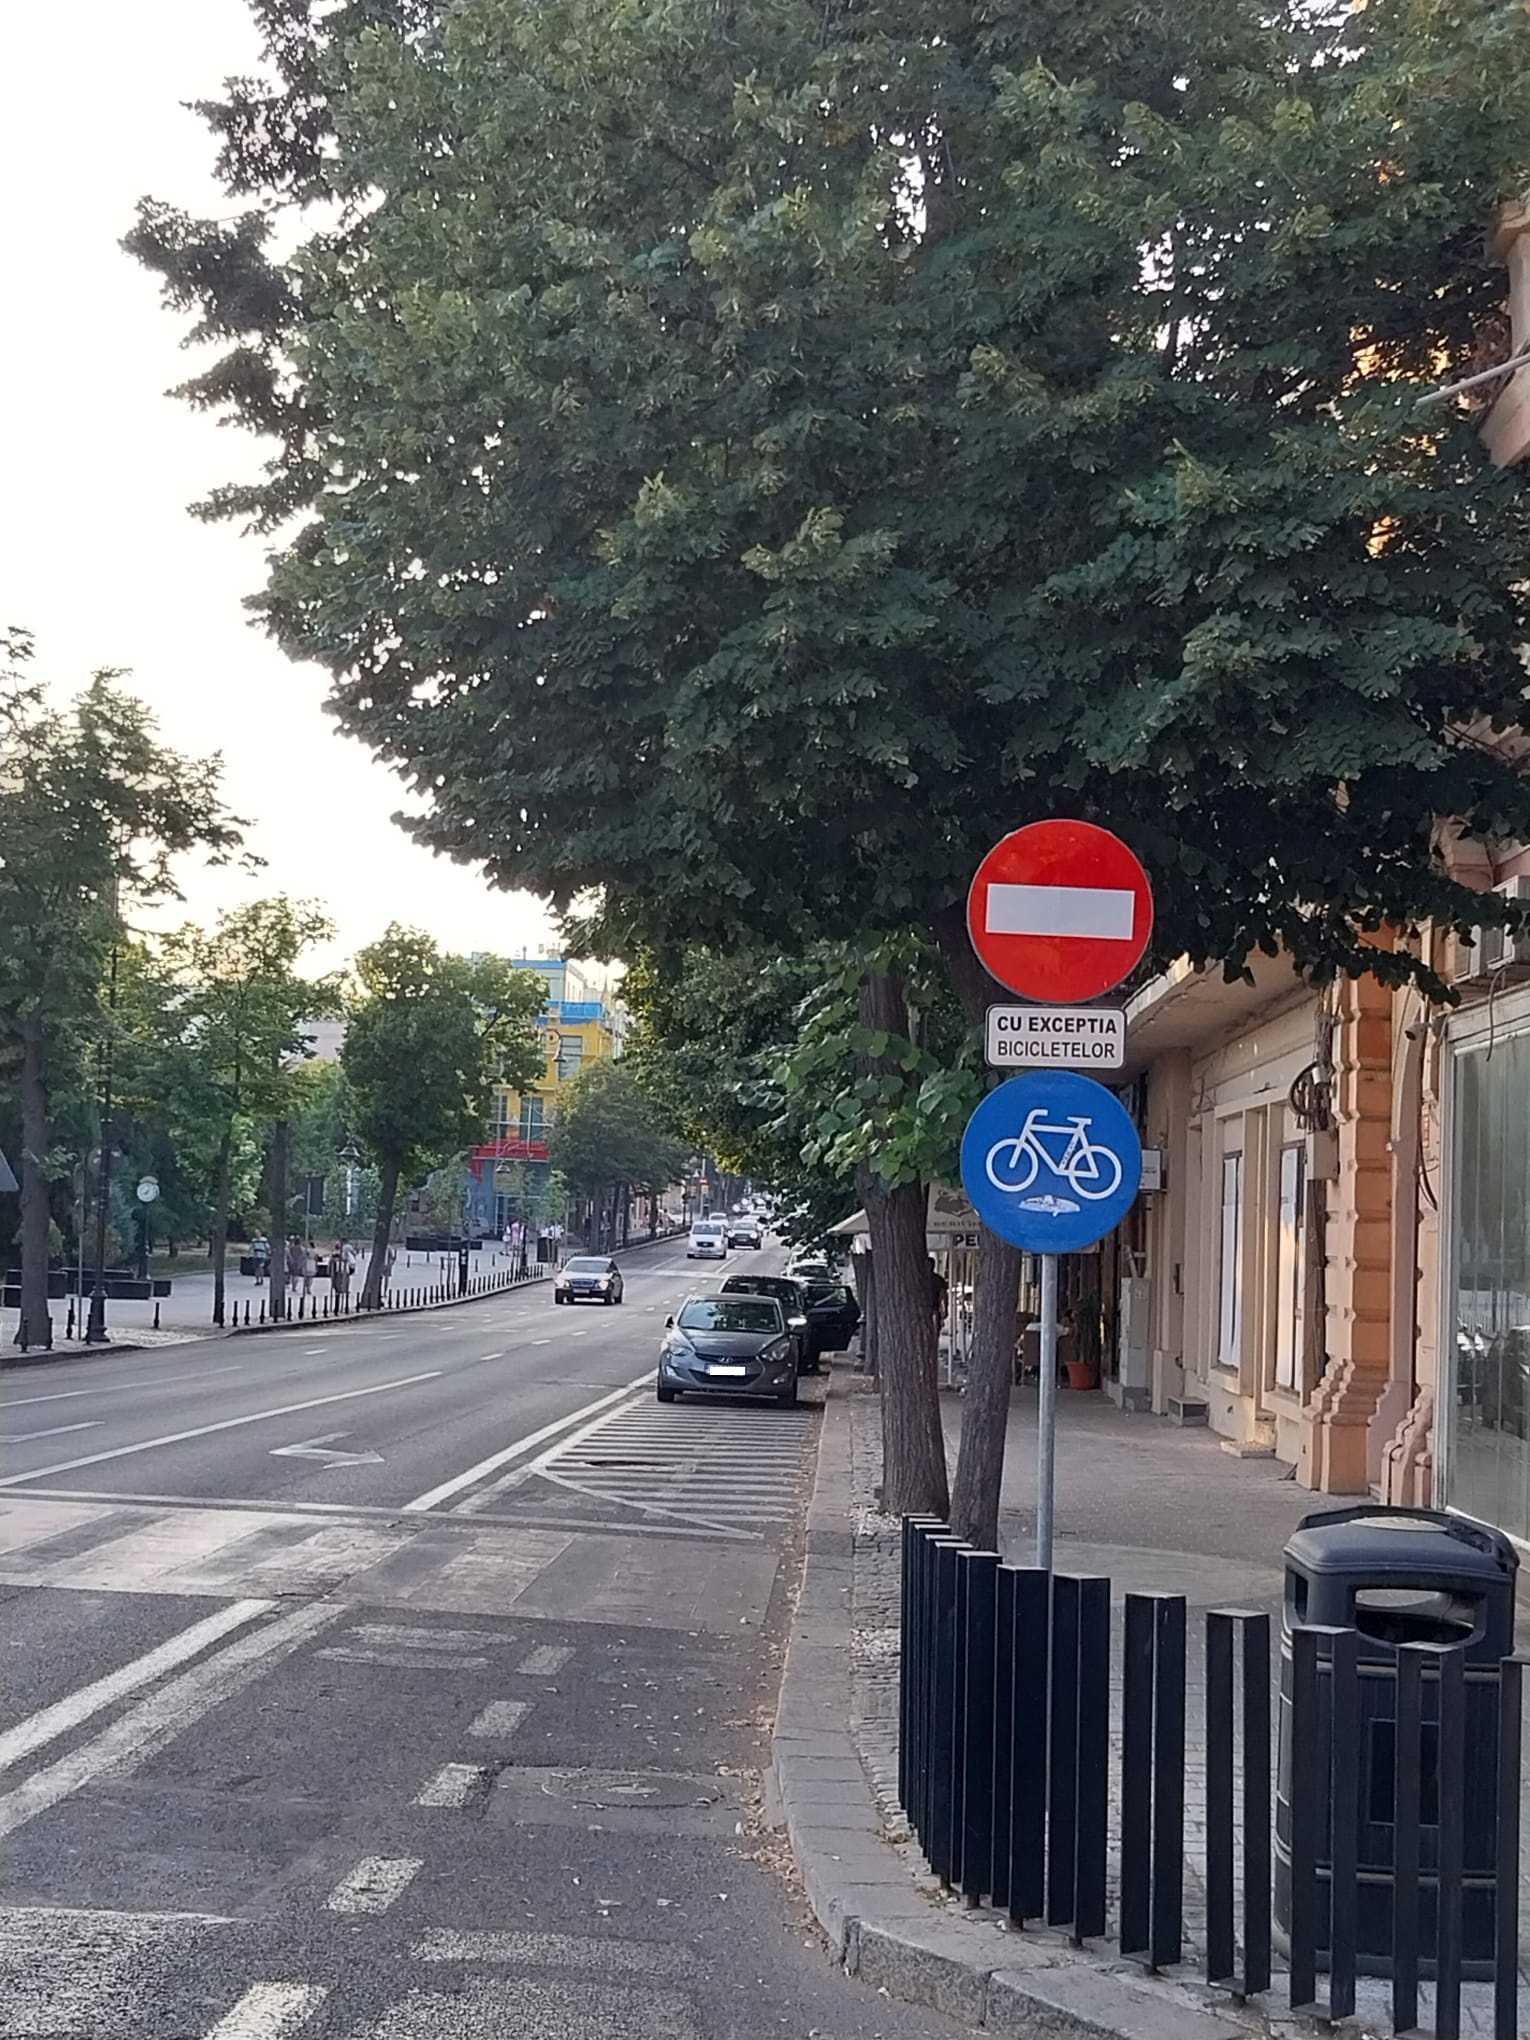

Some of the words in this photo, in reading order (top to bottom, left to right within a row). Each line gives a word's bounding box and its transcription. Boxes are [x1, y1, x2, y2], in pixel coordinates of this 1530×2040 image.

[997, 1016, 1022, 1032] CU
[1028, 1017, 1117, 1034] EXCEPTIA
[997, 1040, 1115, 1058] BICICLETELOR
